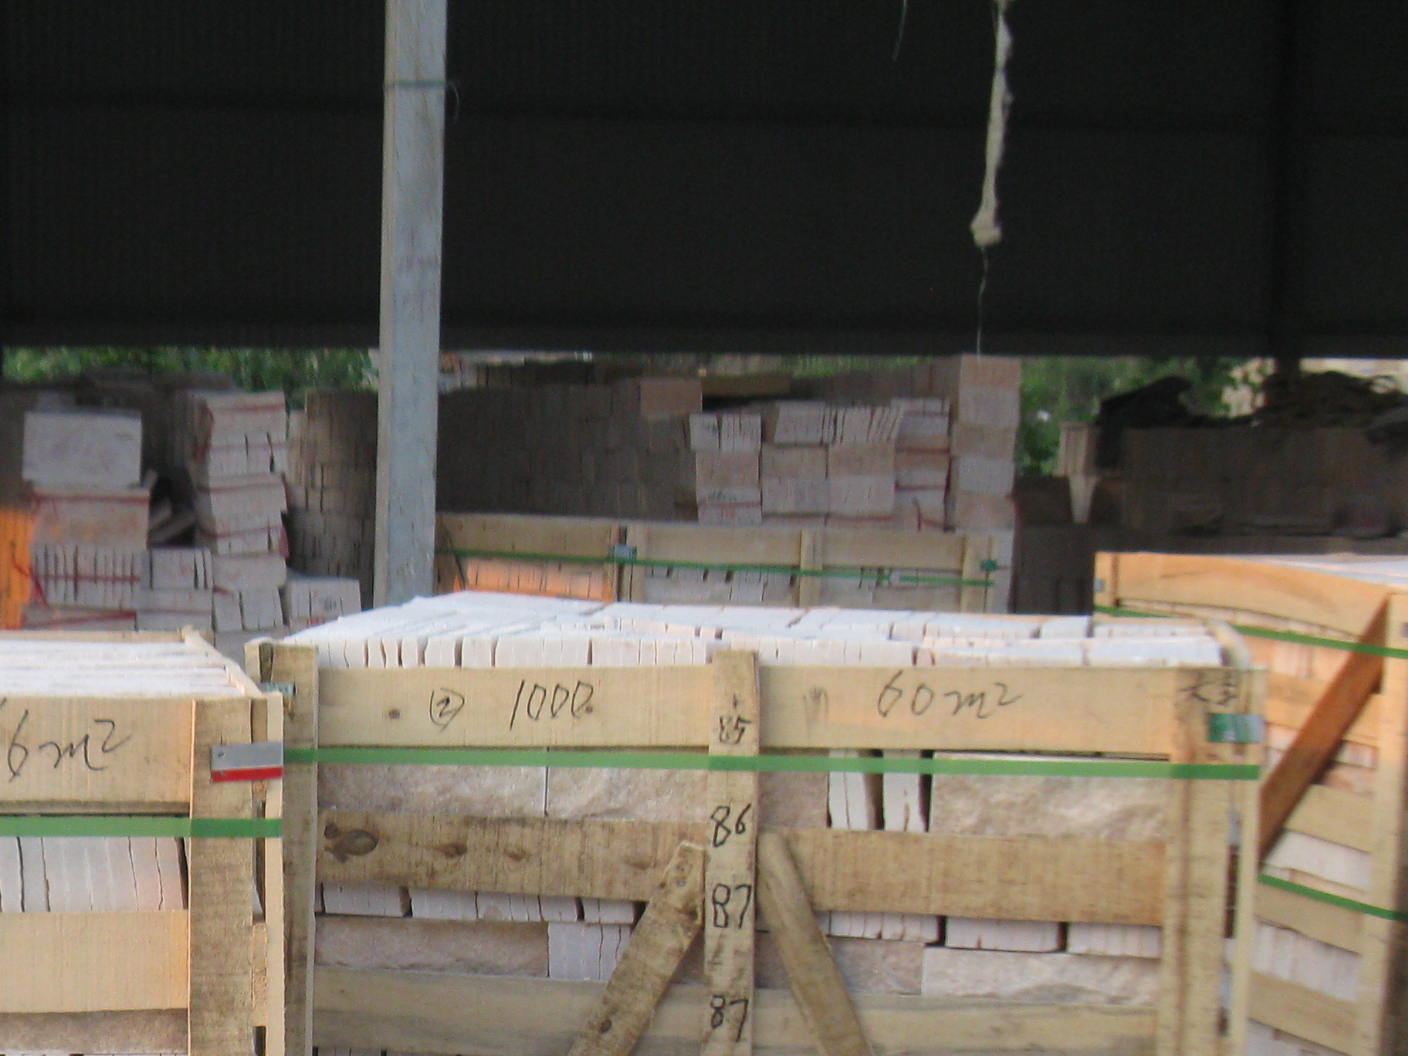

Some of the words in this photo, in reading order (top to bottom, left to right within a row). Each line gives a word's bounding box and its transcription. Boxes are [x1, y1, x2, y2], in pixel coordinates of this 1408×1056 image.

[509, 679, 594, 731] 1000
[710, 803, 752, 848] 86
[711, 882, 753, 929] 87
[710, 994, 750, 1043] 87
